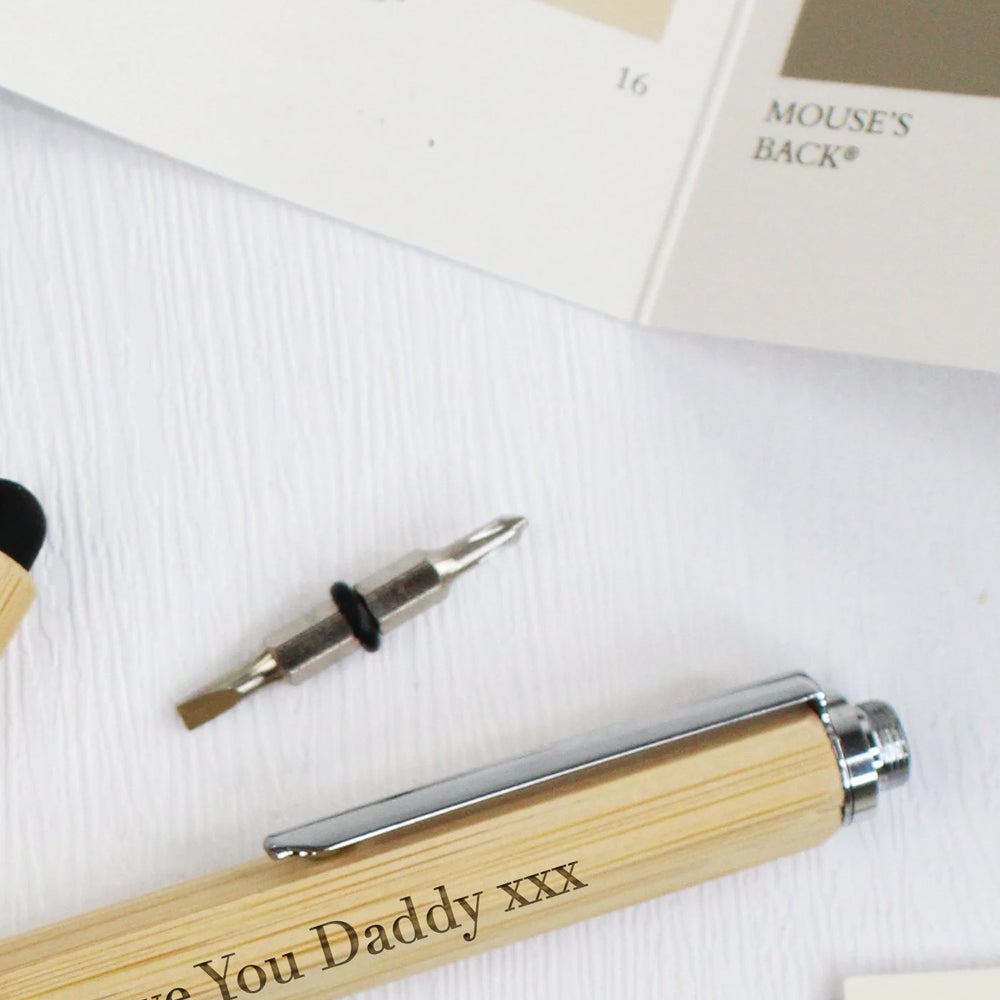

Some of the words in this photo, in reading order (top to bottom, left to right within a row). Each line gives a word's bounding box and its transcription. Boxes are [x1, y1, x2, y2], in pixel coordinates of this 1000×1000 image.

[616, 66, 649, 96] 16
[765, 99, 914, 137] MOUSE'S
[309, 885, 484, 971] Daddy
[497, 860, 589, 913] xxx
